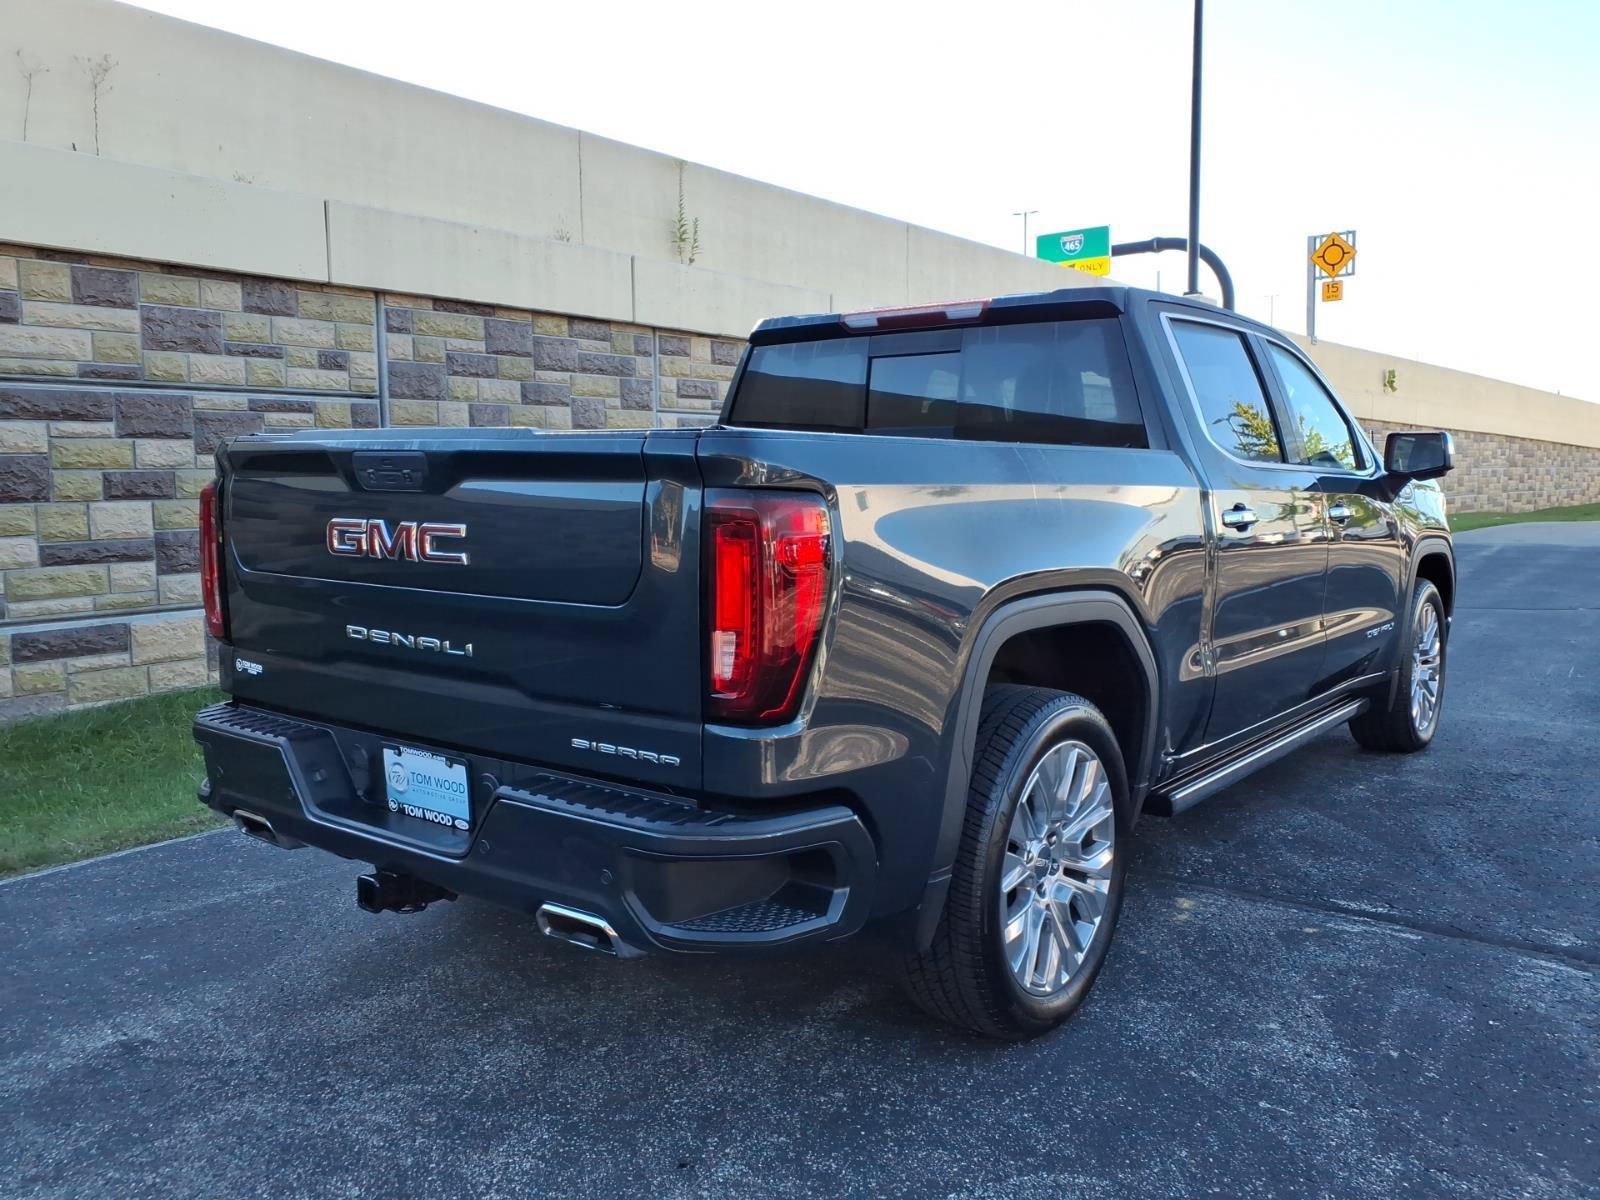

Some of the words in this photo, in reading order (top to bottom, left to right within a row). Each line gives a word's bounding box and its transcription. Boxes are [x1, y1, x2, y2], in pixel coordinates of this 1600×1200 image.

[1064, 240, 1081, 251] 465
[1079, 262, 1104, 272] ONLY
[1326, 282, 1339, 293] 15
[327, 518, 468, 565] GMC
[346, 625, 473, 657] DENALI
[571, 738, 680, 767] SIERRA
[410, 771, 432, 787] TOM
[433, 776, 466, 794] WOOD
[403, 804, 424, 819] TOM
[423, 808, 453, 826] WOOD
